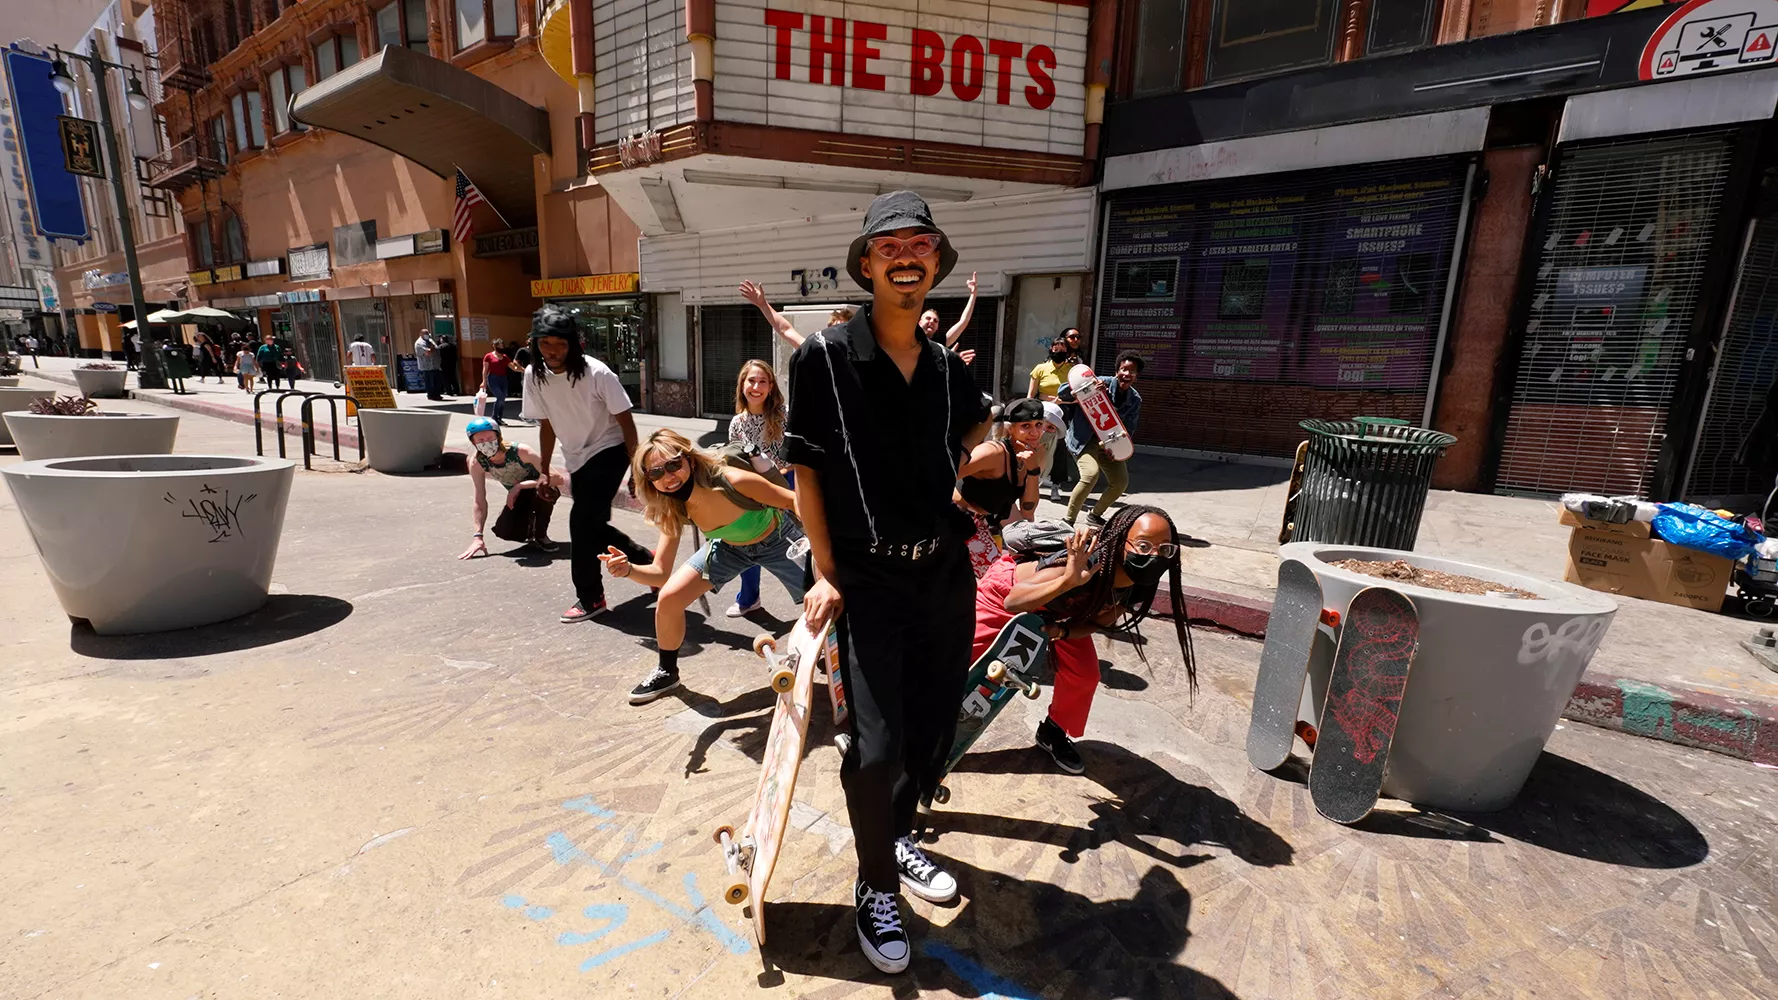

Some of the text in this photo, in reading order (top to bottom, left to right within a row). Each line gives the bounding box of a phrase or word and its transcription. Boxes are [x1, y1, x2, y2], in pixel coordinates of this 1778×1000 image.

[765, 8, 1057, 110] THE BOTS
[1346, 224, 1424, 239] SMARTPHONE
[477, 236, 512, 253] UNITED
[1110, 241, 1190, 255] COMPUTER ISSUES?
[1358, 240, 1406, 253] ISSUES?
[1569, 270, 1636, 281] COMPUTER
[533, 280, 553, 296] SAN
[559, 277, 586, 295] JUDAS
[1573, 282, 1626, 295] ISSUES?
[1110, 308, 1174, 317] FREE DIAGNOSTICS
[1083, 392, 1104, 409] REAL
[1580, 549, 1632, 564] FACE MASK
